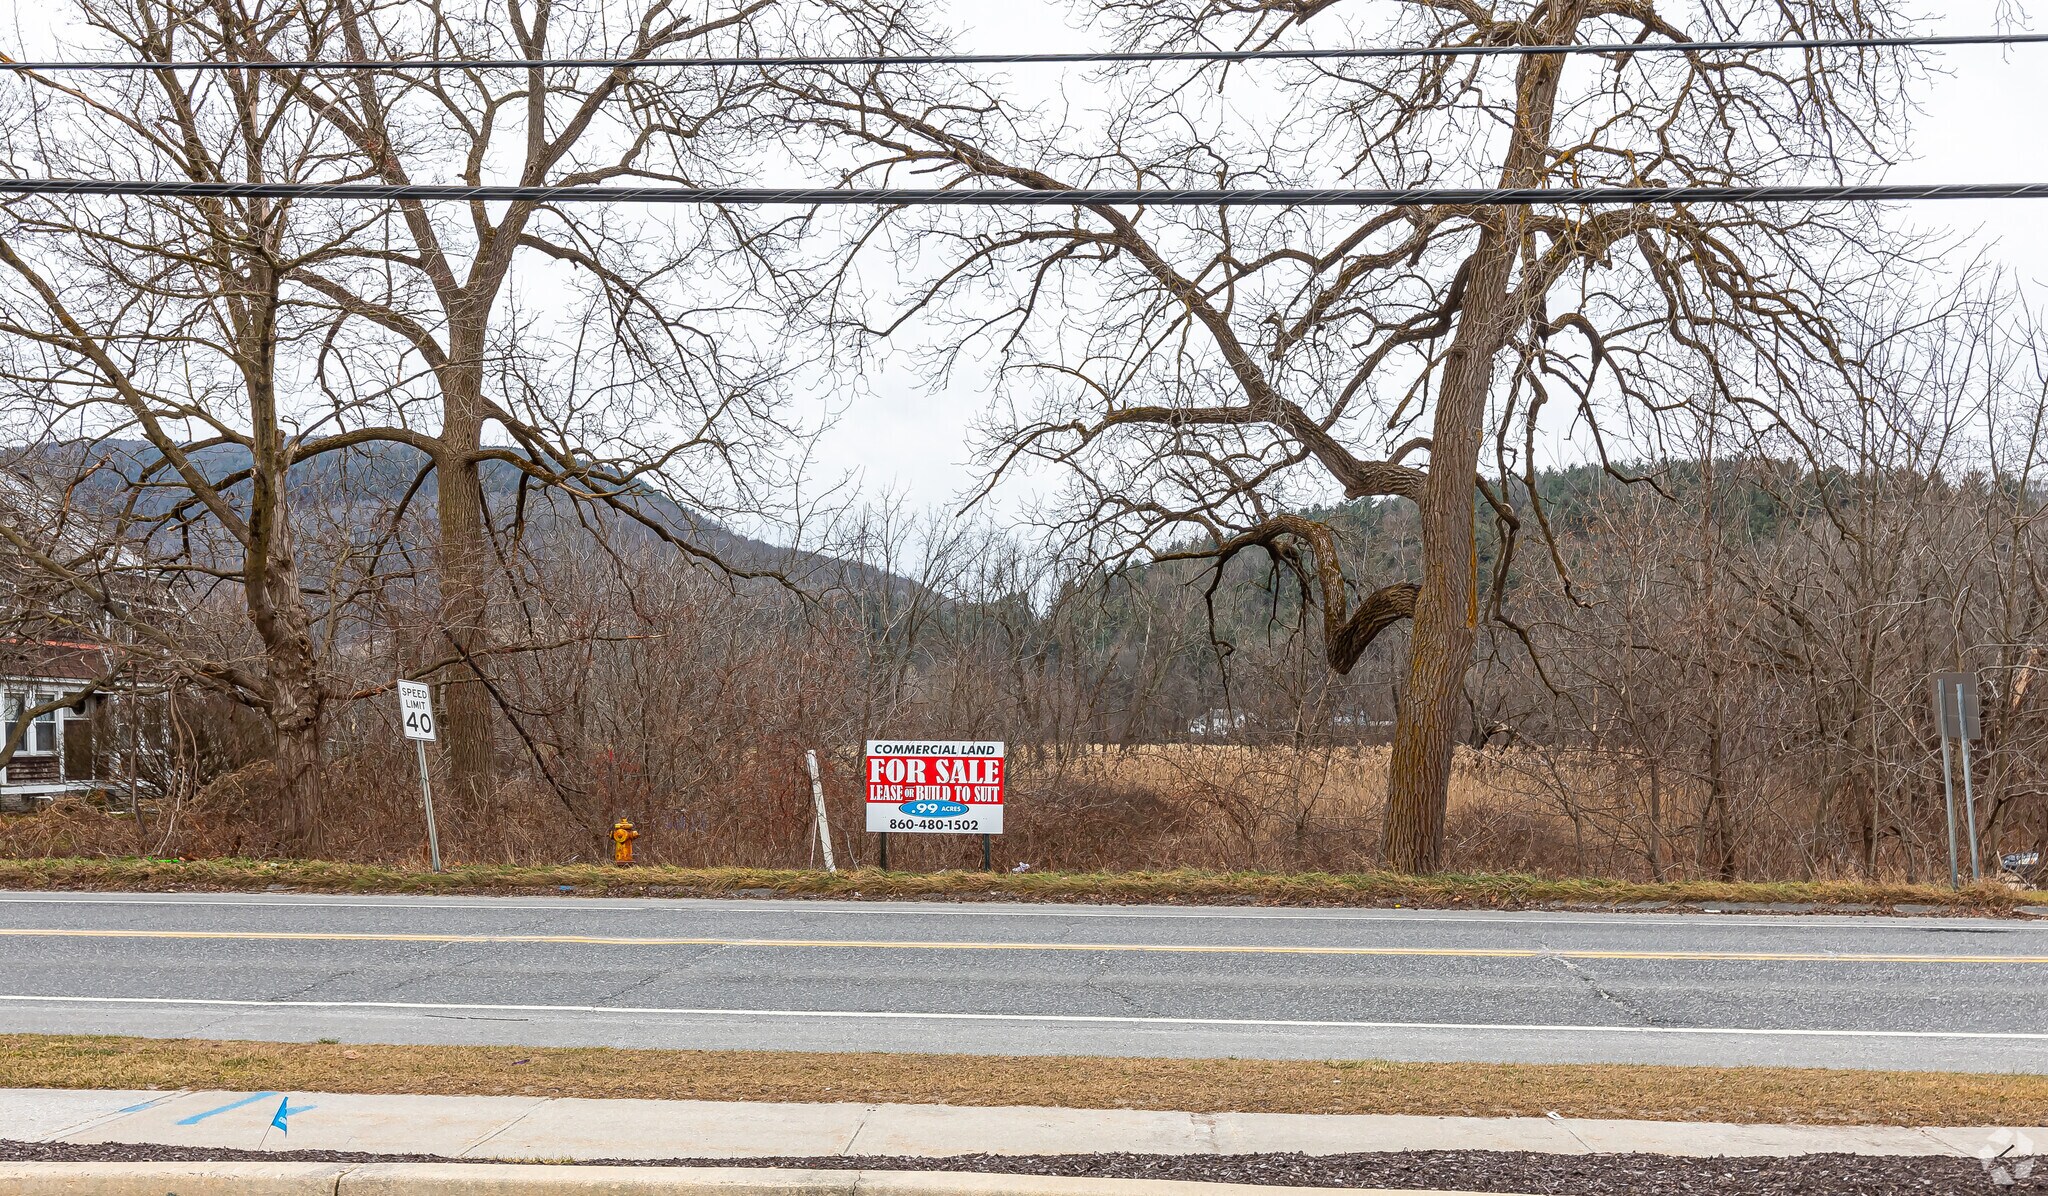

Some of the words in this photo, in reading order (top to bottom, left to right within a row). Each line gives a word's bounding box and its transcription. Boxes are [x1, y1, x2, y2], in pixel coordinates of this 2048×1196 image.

[402, 687, 427, 699] SPEED
[406, 699, 425, 710] LIMIT
[406, 711, 432, 733] 40
[874, 744, 957, 755] COMMERCIAL
[961, 745, 995, 755] LAND
[869, 758, 926, 783] FOR
[935, 759, 1000, 784] SALE
[869, 785, 903, 801] LEASE
[904, 788, 914, 798] OR
[915, 785, 951, 801] BUILD
[954, 786, 971, 802] TO
[974, 786, 1000, 802] SUIT
[911, 803, 938, 814] .99
[889, 819, 979, 830] 860-480-1502
